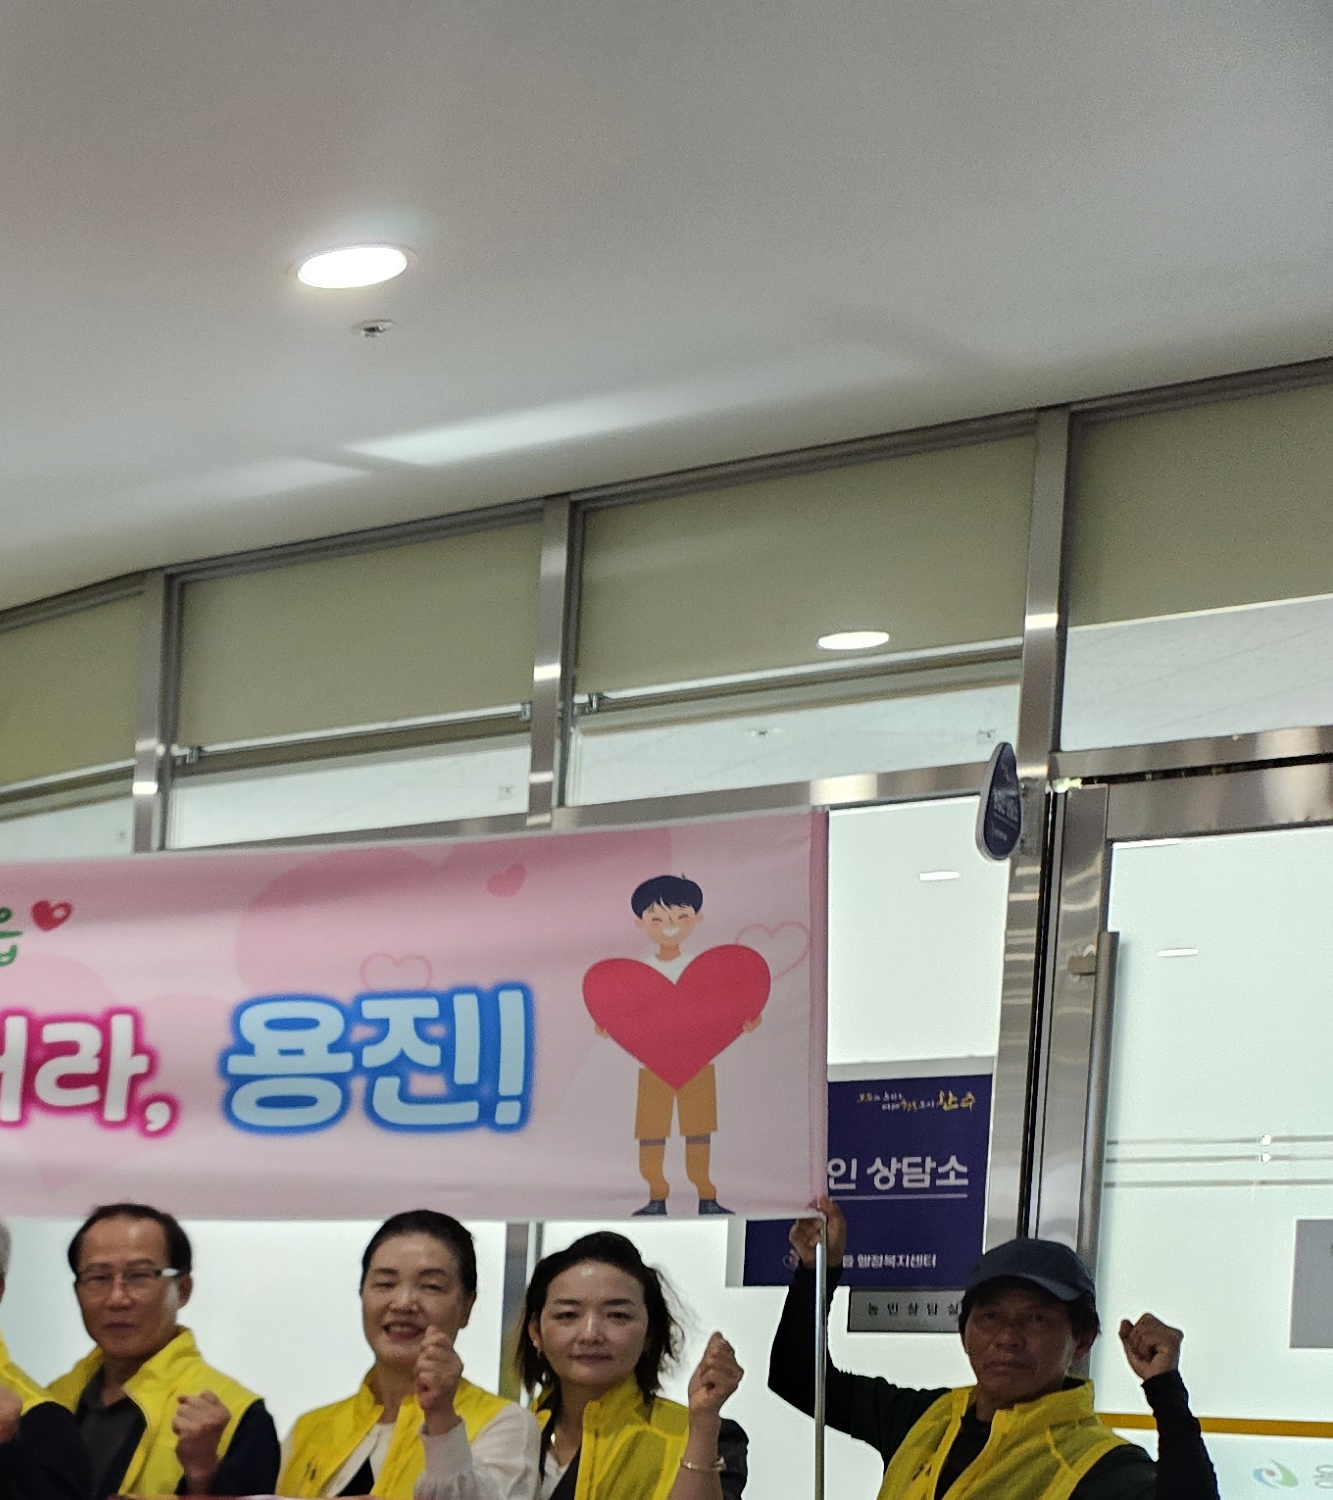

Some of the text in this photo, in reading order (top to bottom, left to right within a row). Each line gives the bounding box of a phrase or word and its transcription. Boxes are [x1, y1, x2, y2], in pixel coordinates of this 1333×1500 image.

[223, 984, 529, 1131] 용진!
[828, 1155, 969, 1190] 인 상담소
